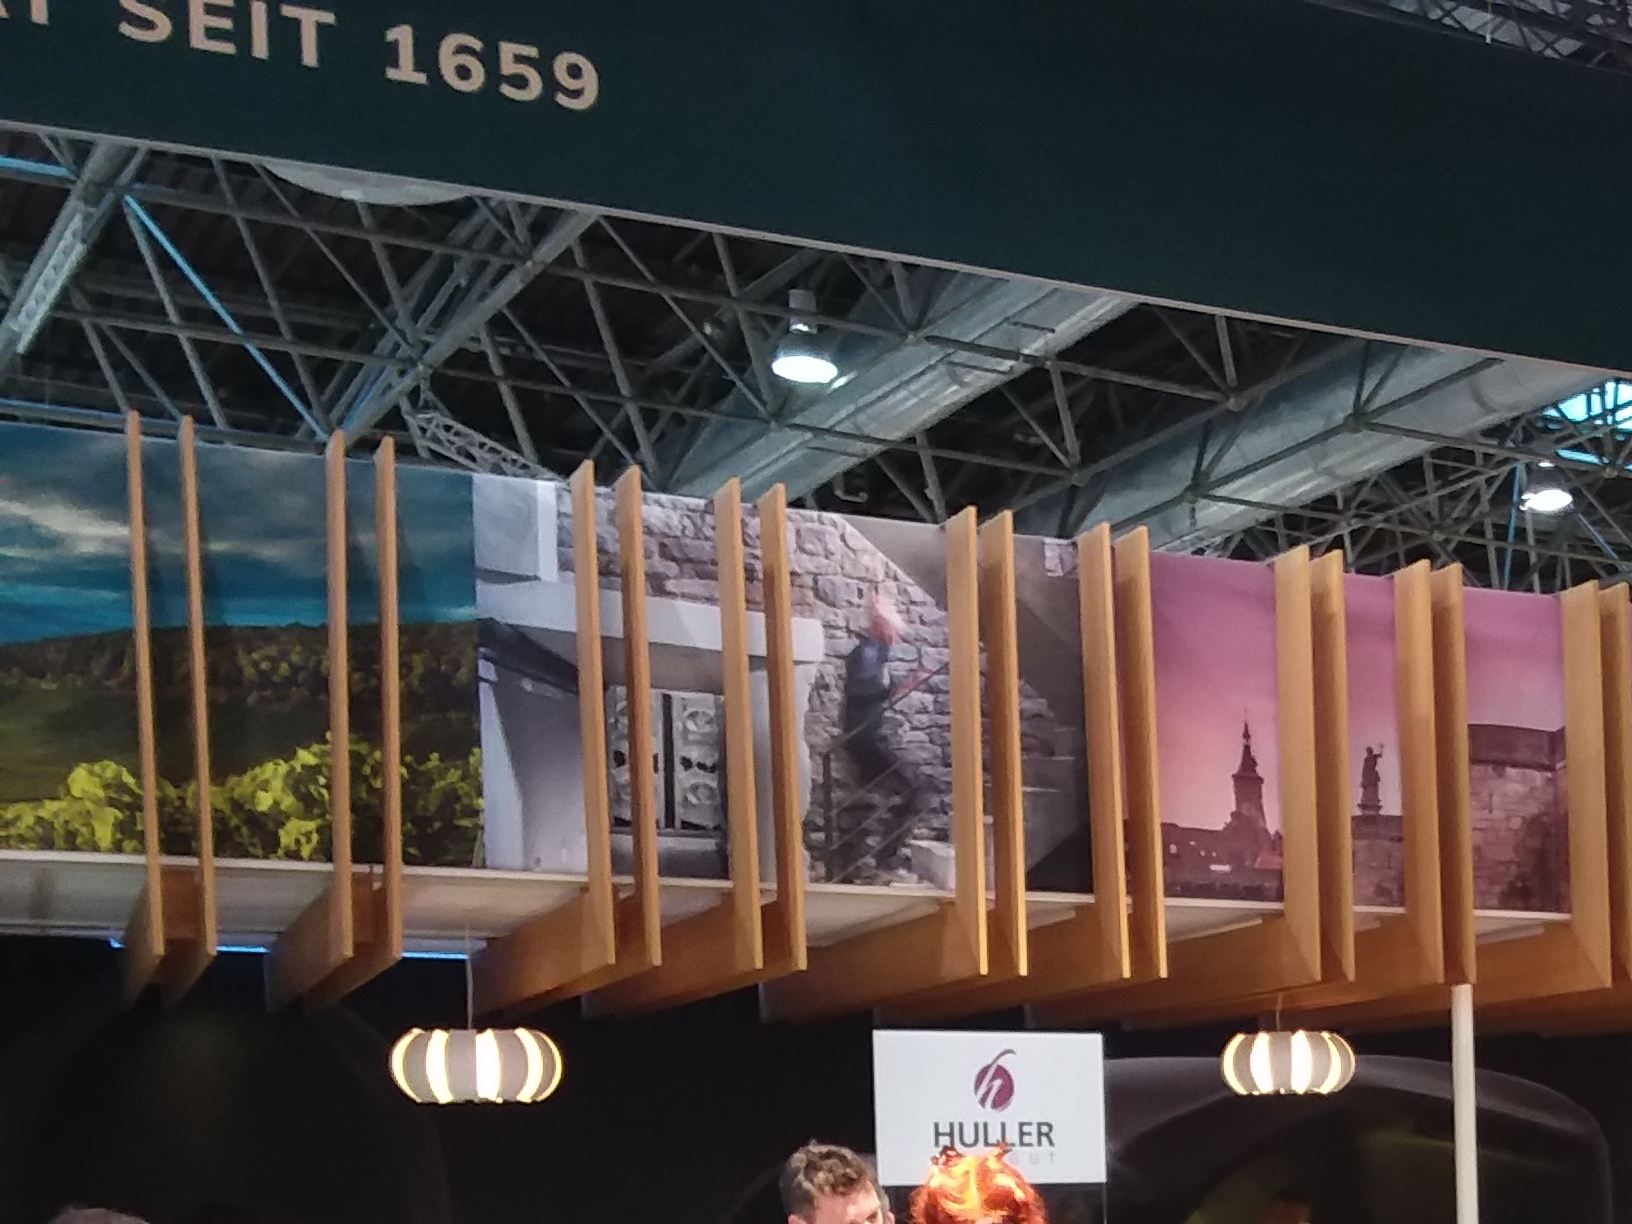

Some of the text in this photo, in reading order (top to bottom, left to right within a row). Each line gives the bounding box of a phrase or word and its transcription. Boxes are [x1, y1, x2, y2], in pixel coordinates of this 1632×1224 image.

[117, 0, 600, 111] SEIT 1659
[933, 1121, 1056, 1149] HULLER
